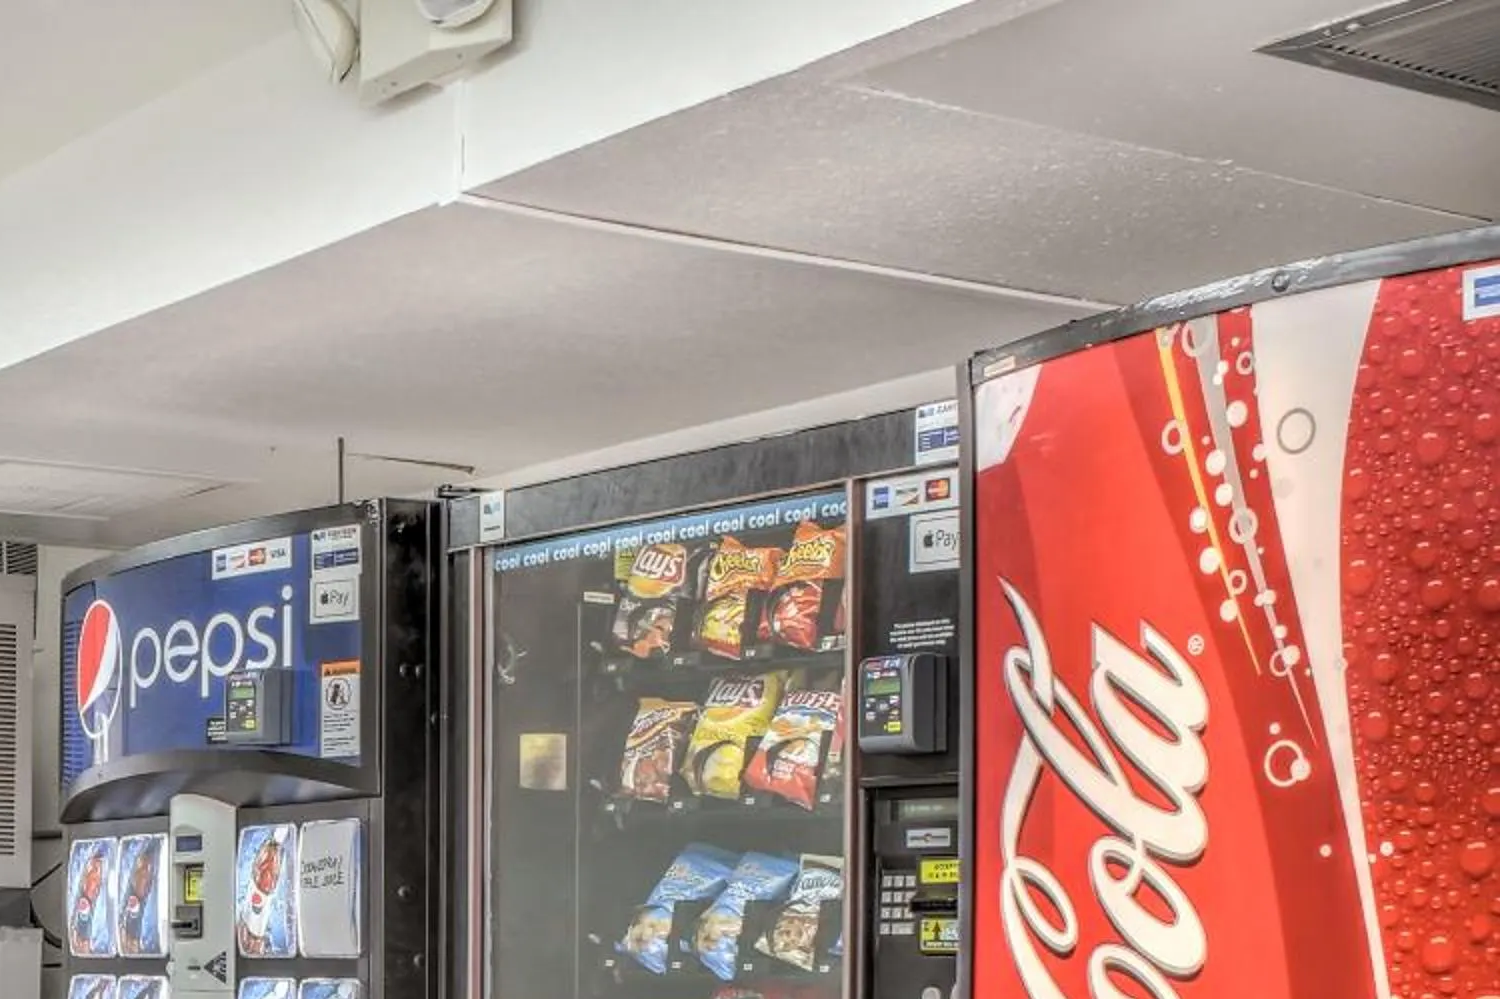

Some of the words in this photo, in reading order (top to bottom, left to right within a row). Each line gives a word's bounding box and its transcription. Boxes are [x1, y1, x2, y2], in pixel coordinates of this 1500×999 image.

[495, 554, 520, 572] cool
[524, 548, 549, 567] cool
[553, 542, 580, 561] cool
[583, 537, 611, 556] cool
[615, 531, 643, 550] cool
[647, 525, 675, 545] cool
[680, 520, 709, 540] cool
[713, 514, 744, 534] cool
[748, 508, 780, 529] cool
[784, 502, 817, 523] cool
[329, 590, 350, 607] Pay
[130, 584, 293, 709] pepsi
